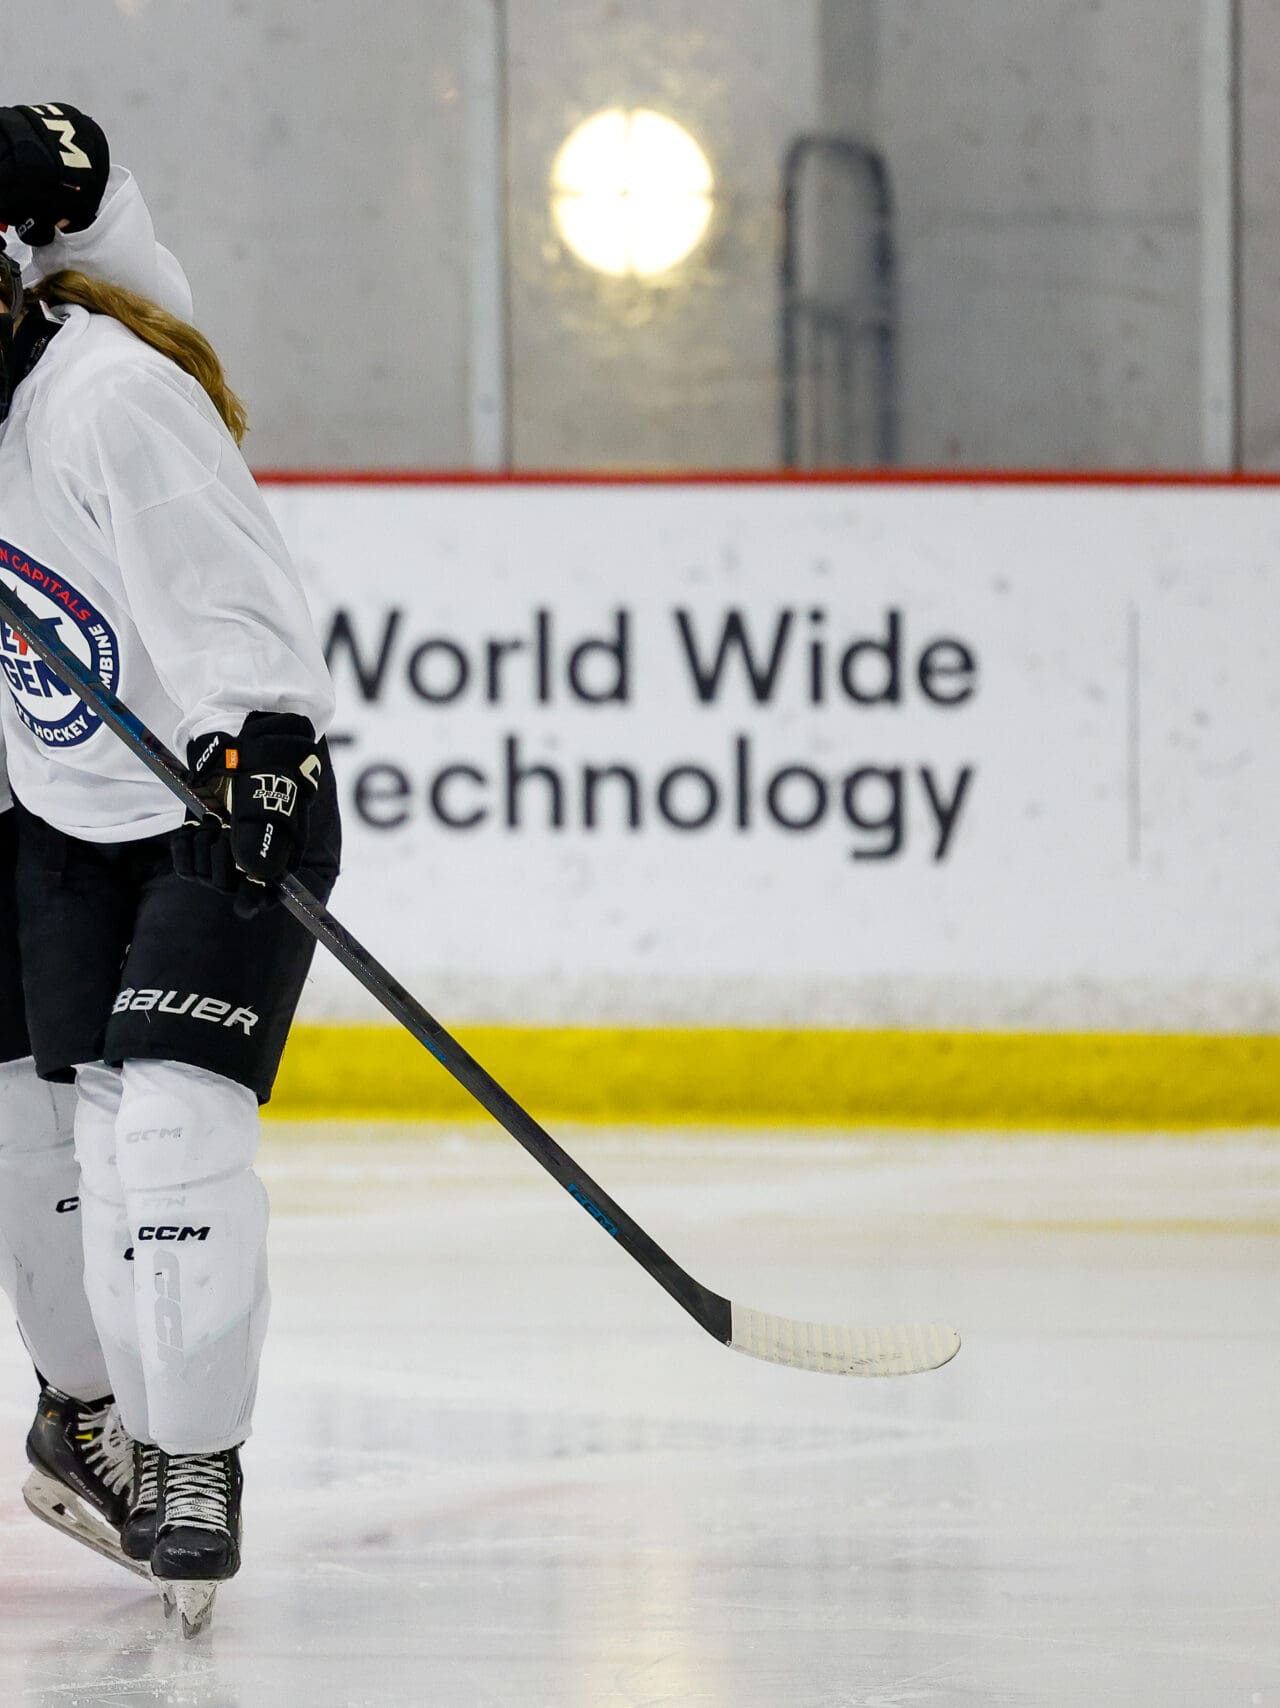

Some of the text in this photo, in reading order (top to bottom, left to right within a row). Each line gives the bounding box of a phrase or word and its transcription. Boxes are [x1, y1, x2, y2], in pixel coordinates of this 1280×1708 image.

[12, 555, 91, 621] CAPITALS
[325, 606, 977, 704] World Wide
[33, 714, 89, 742] HOCKEY
[196, 735, 220, 771] CCM
[327, 733, 972, 863] echnology
[259, 823, 274, 858] CCM
[111, 987, 260, 1036] BAUER
[137, 1226, 211, 1242] CCM
